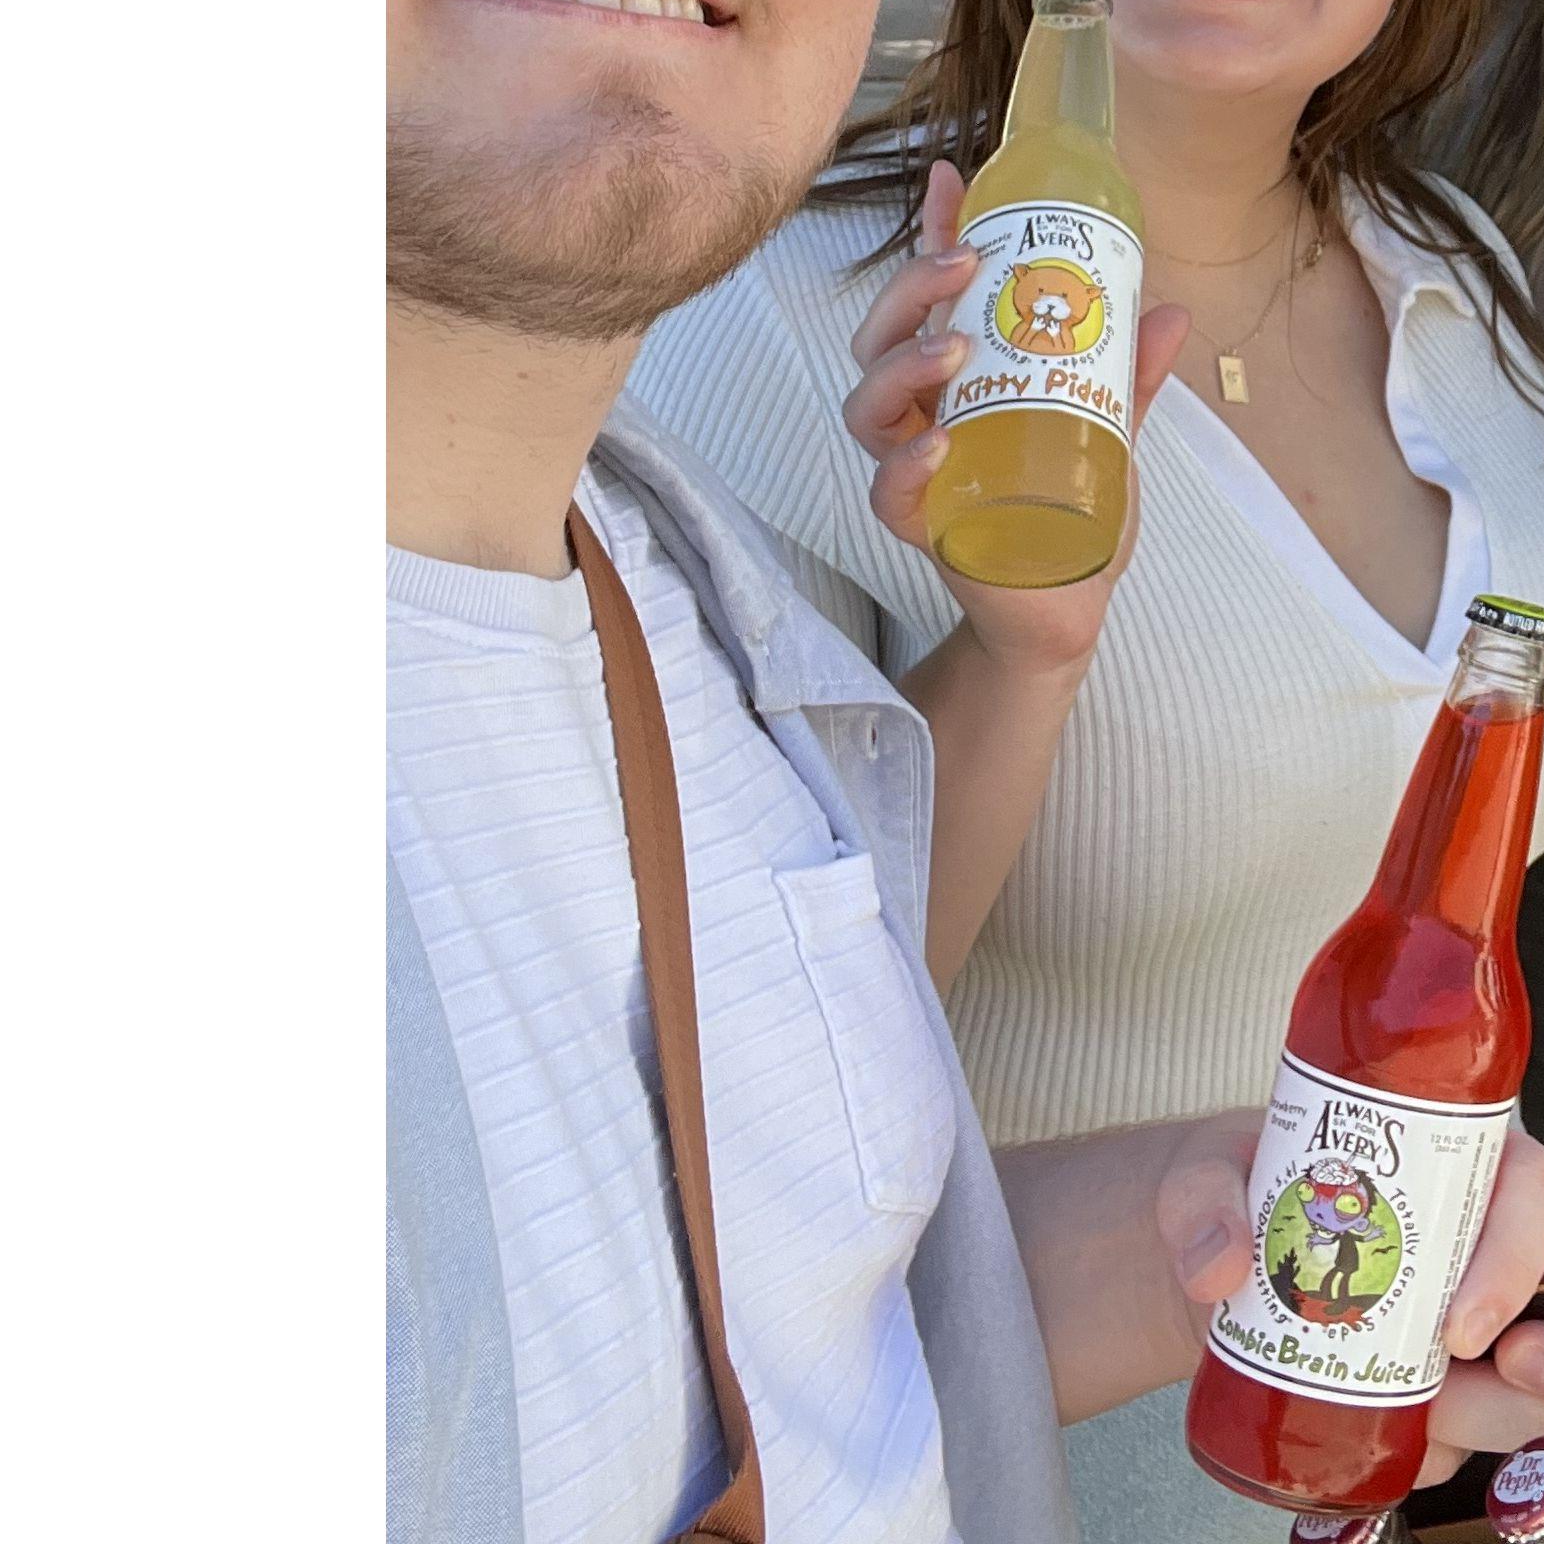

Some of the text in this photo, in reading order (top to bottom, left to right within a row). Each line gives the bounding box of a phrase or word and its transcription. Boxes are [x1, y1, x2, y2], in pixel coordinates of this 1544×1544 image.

[954, 368, 1123, 422] Kitty Piddle
[1305, 1106, 1404, 1178] AVERY'S
[1389, 1187, 1421, 1256] Totally
[1379, 1266, 1416, 1317] Gross
[1217, 1299, 1417, 1385] Zombie Brain Juice
[1520, 1456, 1543, 1471] Dr
